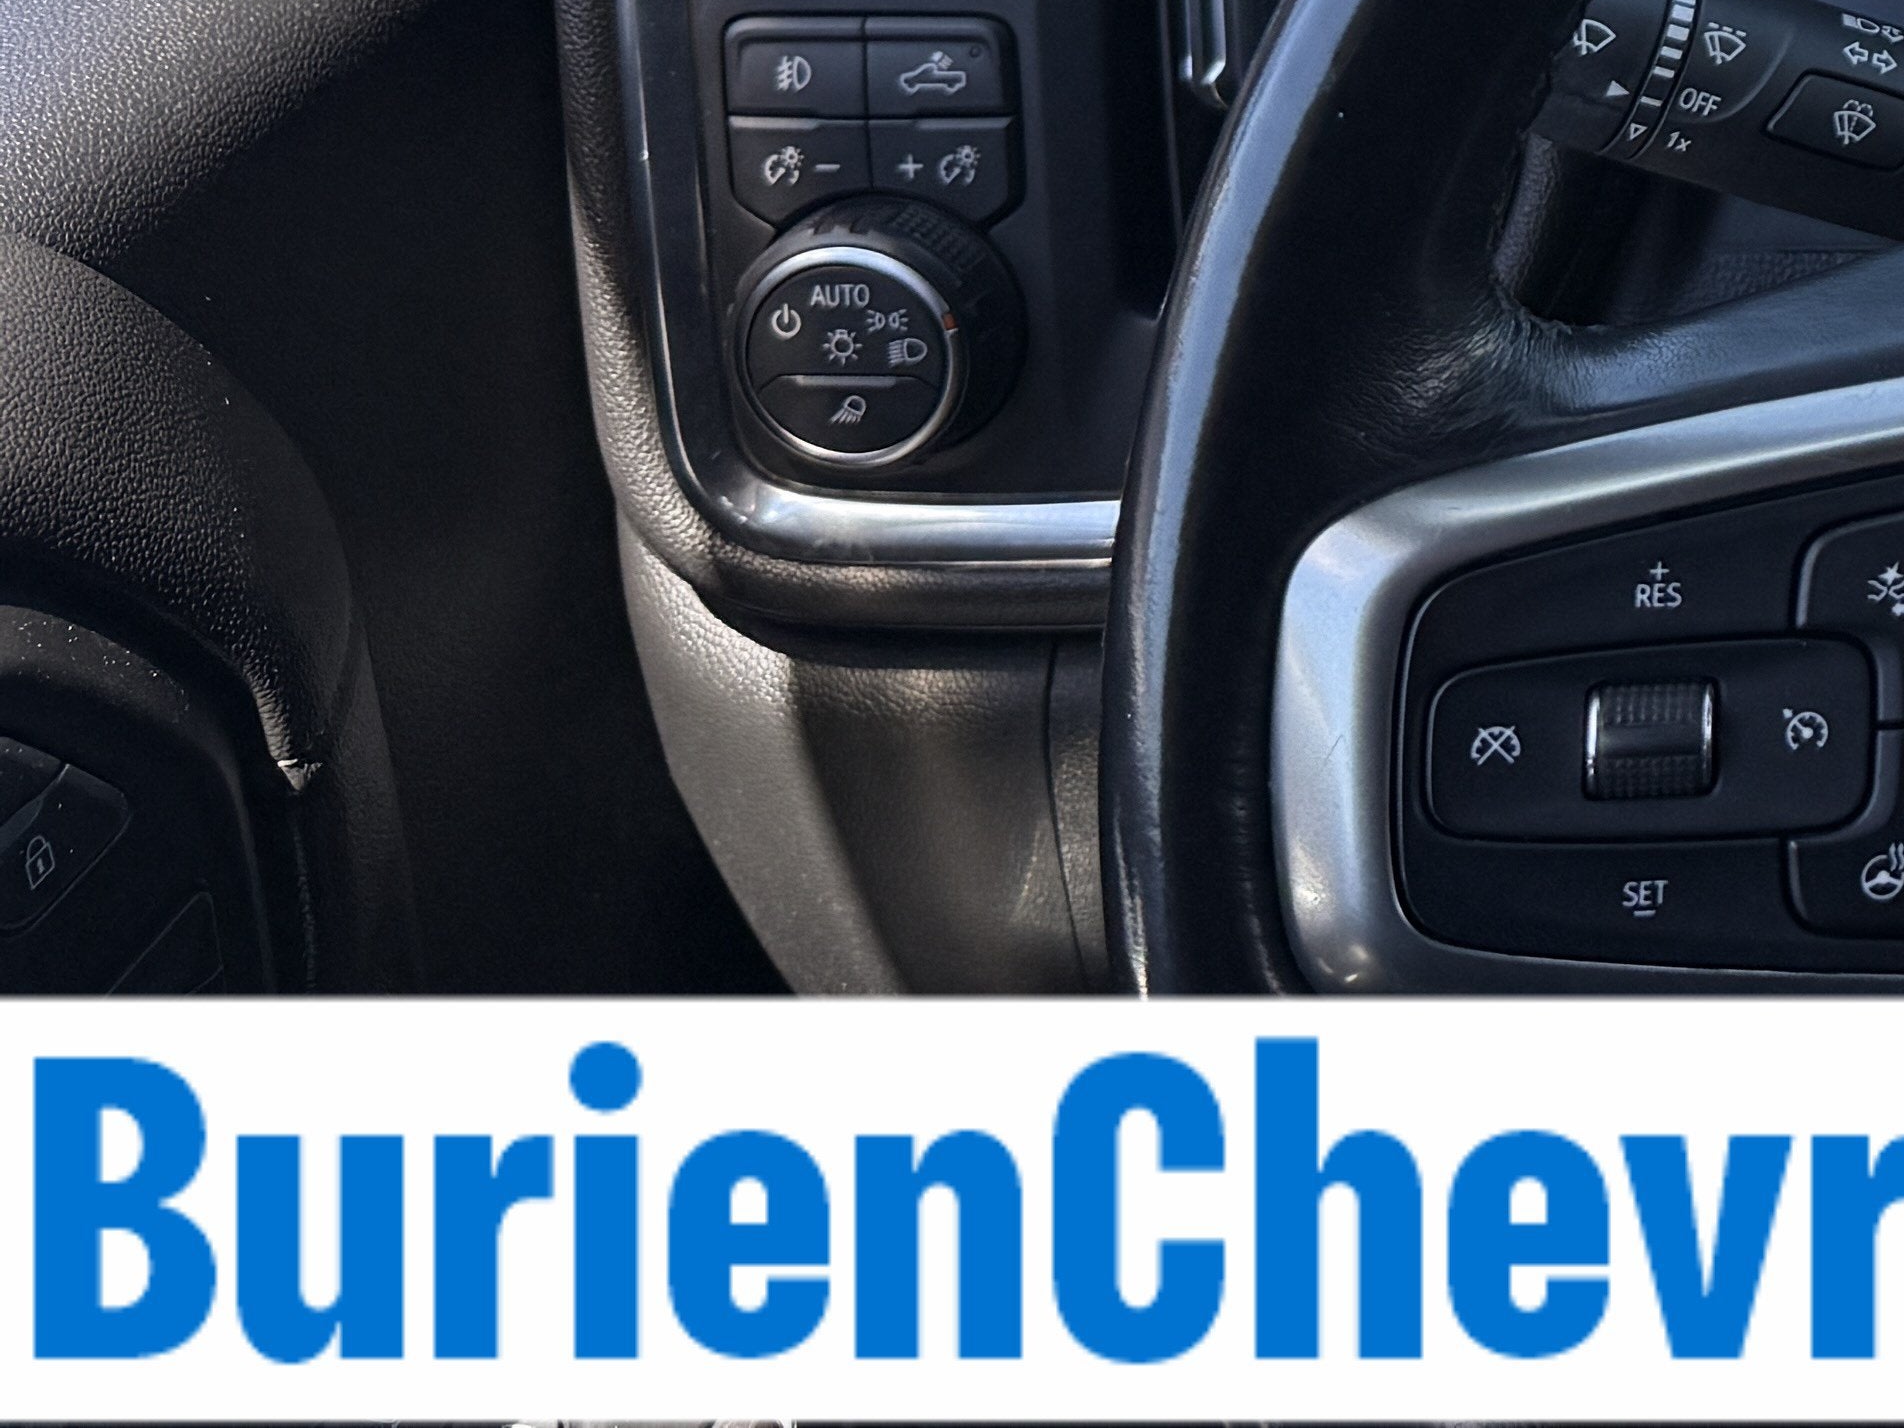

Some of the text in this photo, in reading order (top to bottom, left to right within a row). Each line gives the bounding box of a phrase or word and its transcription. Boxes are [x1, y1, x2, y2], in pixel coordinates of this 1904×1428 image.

[1678, 87, 1721, 117] OFF
[1665, 131, 1692, 152] 1x
[811, 284, 870, 308] AUTO
[1635, 582, 1683, 609] RES
[1622, 880, 1669, 908] SET
